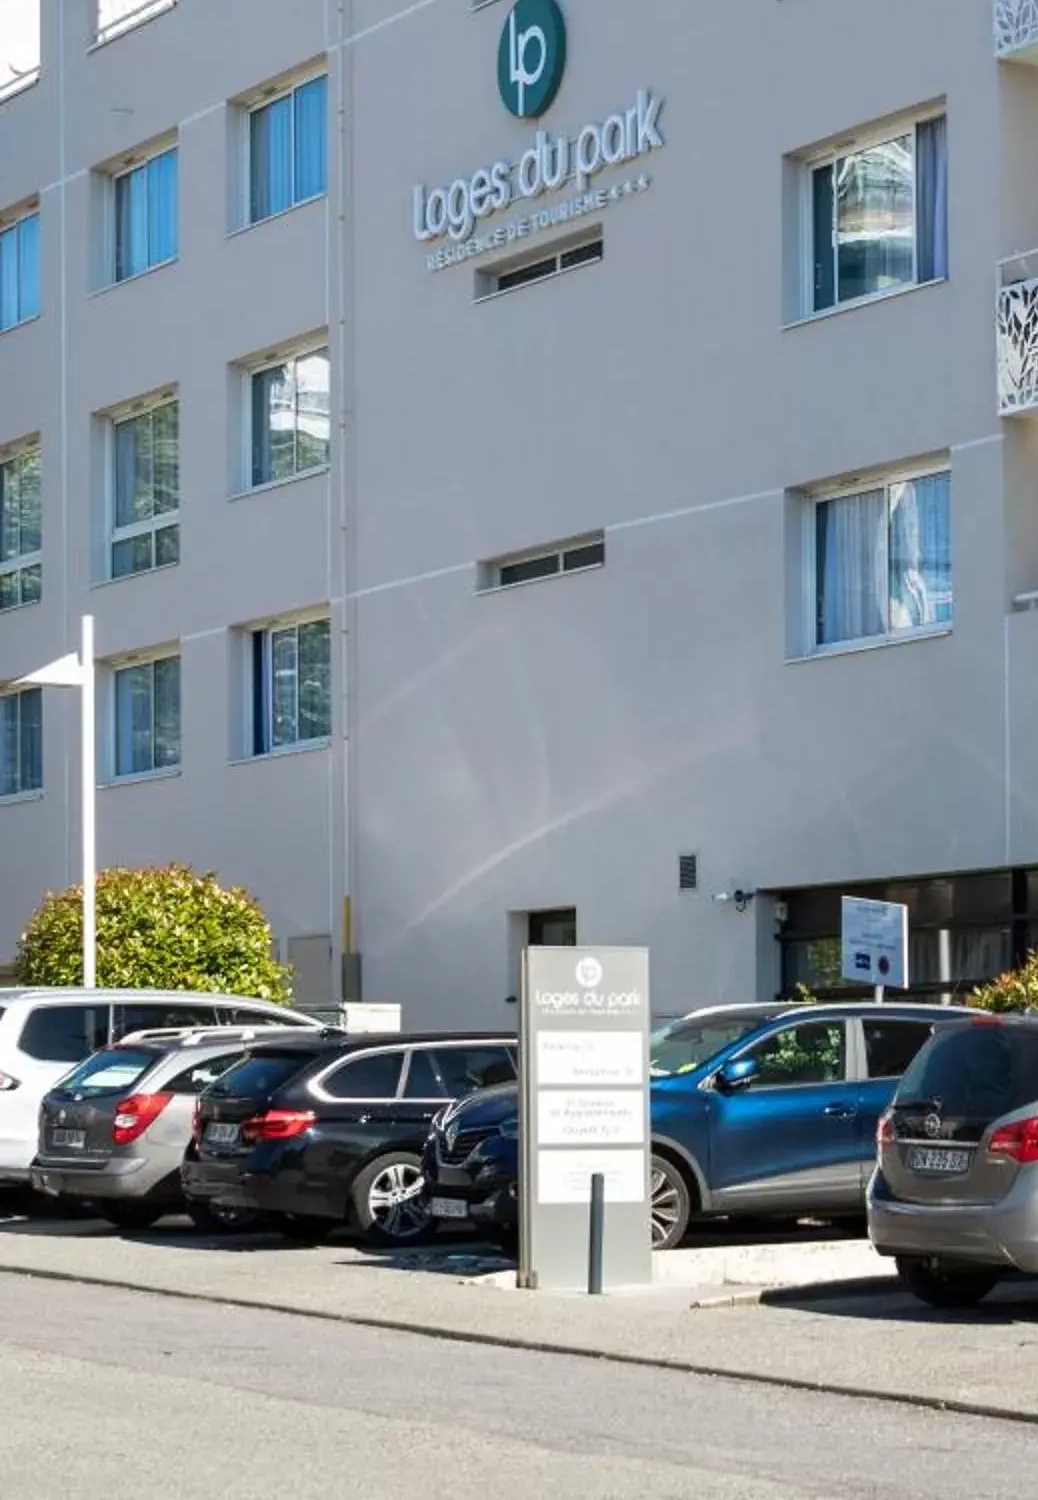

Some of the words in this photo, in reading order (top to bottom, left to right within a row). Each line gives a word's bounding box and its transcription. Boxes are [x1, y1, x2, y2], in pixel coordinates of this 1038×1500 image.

[412, 160, 511, 241] Loges
[518, 130, 569, 198] du
[576, 88, 665, 191] park
